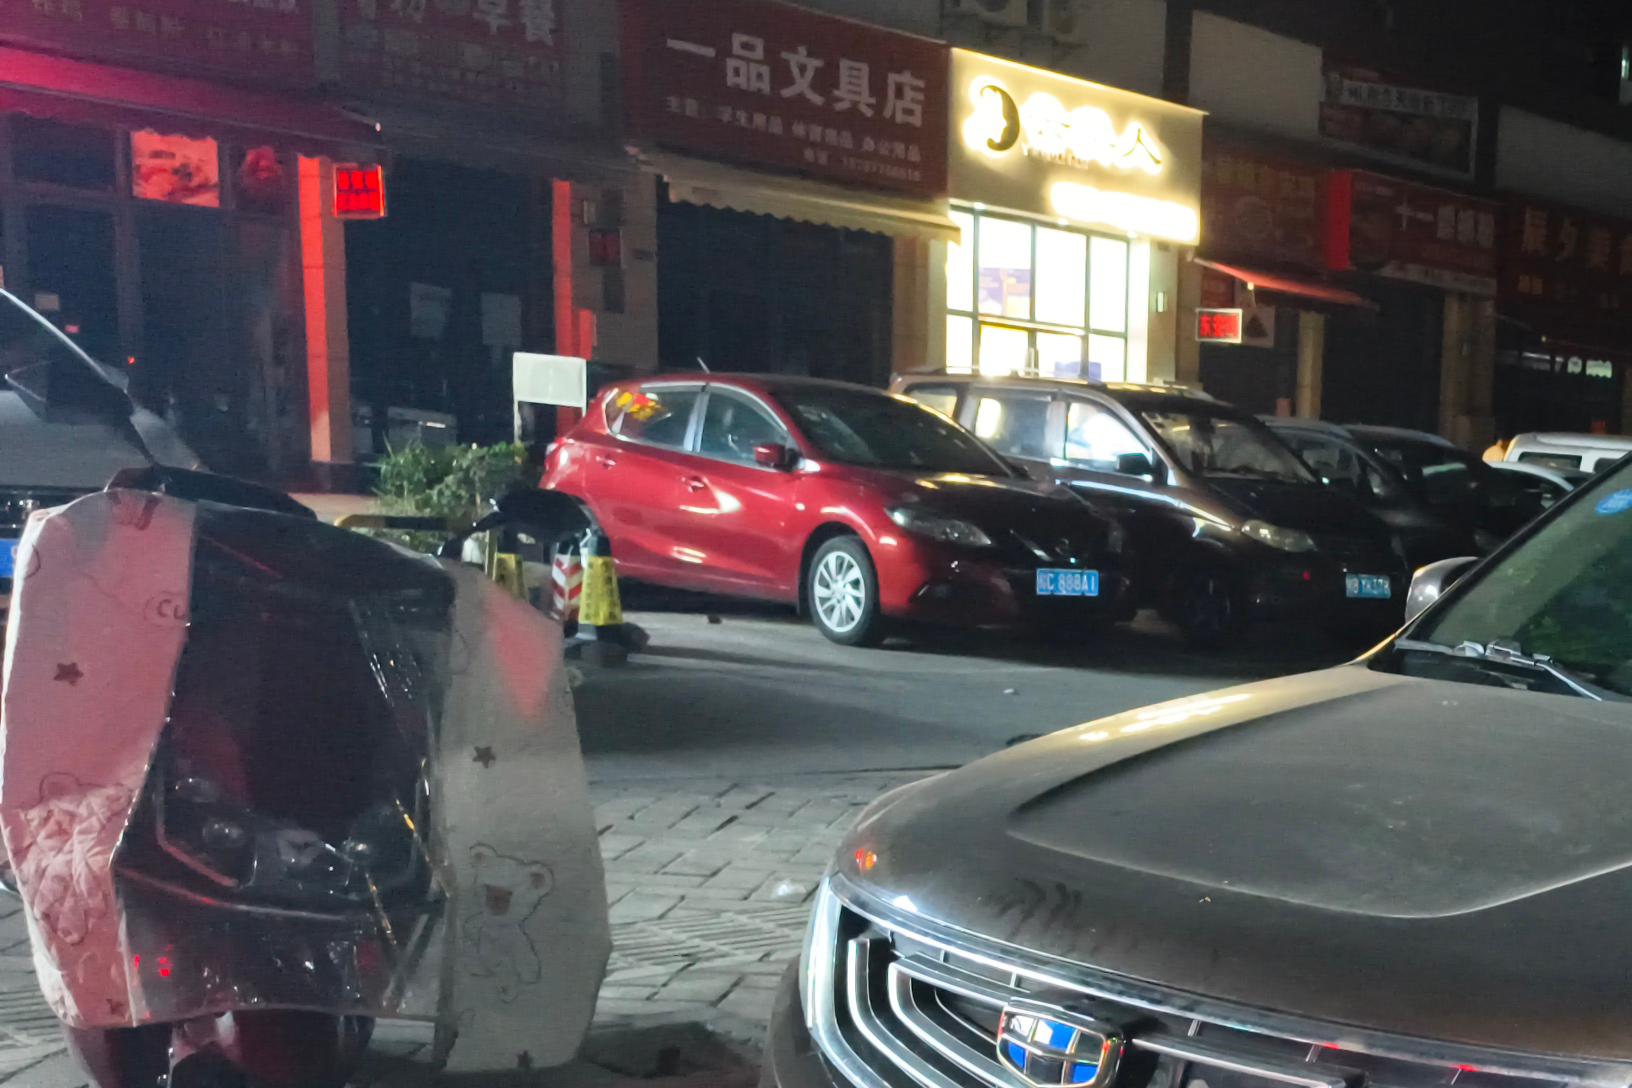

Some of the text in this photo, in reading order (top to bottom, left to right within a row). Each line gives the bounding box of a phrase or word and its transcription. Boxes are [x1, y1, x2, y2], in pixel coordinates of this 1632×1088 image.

[666, 32, 926, 128] 一品文具店
